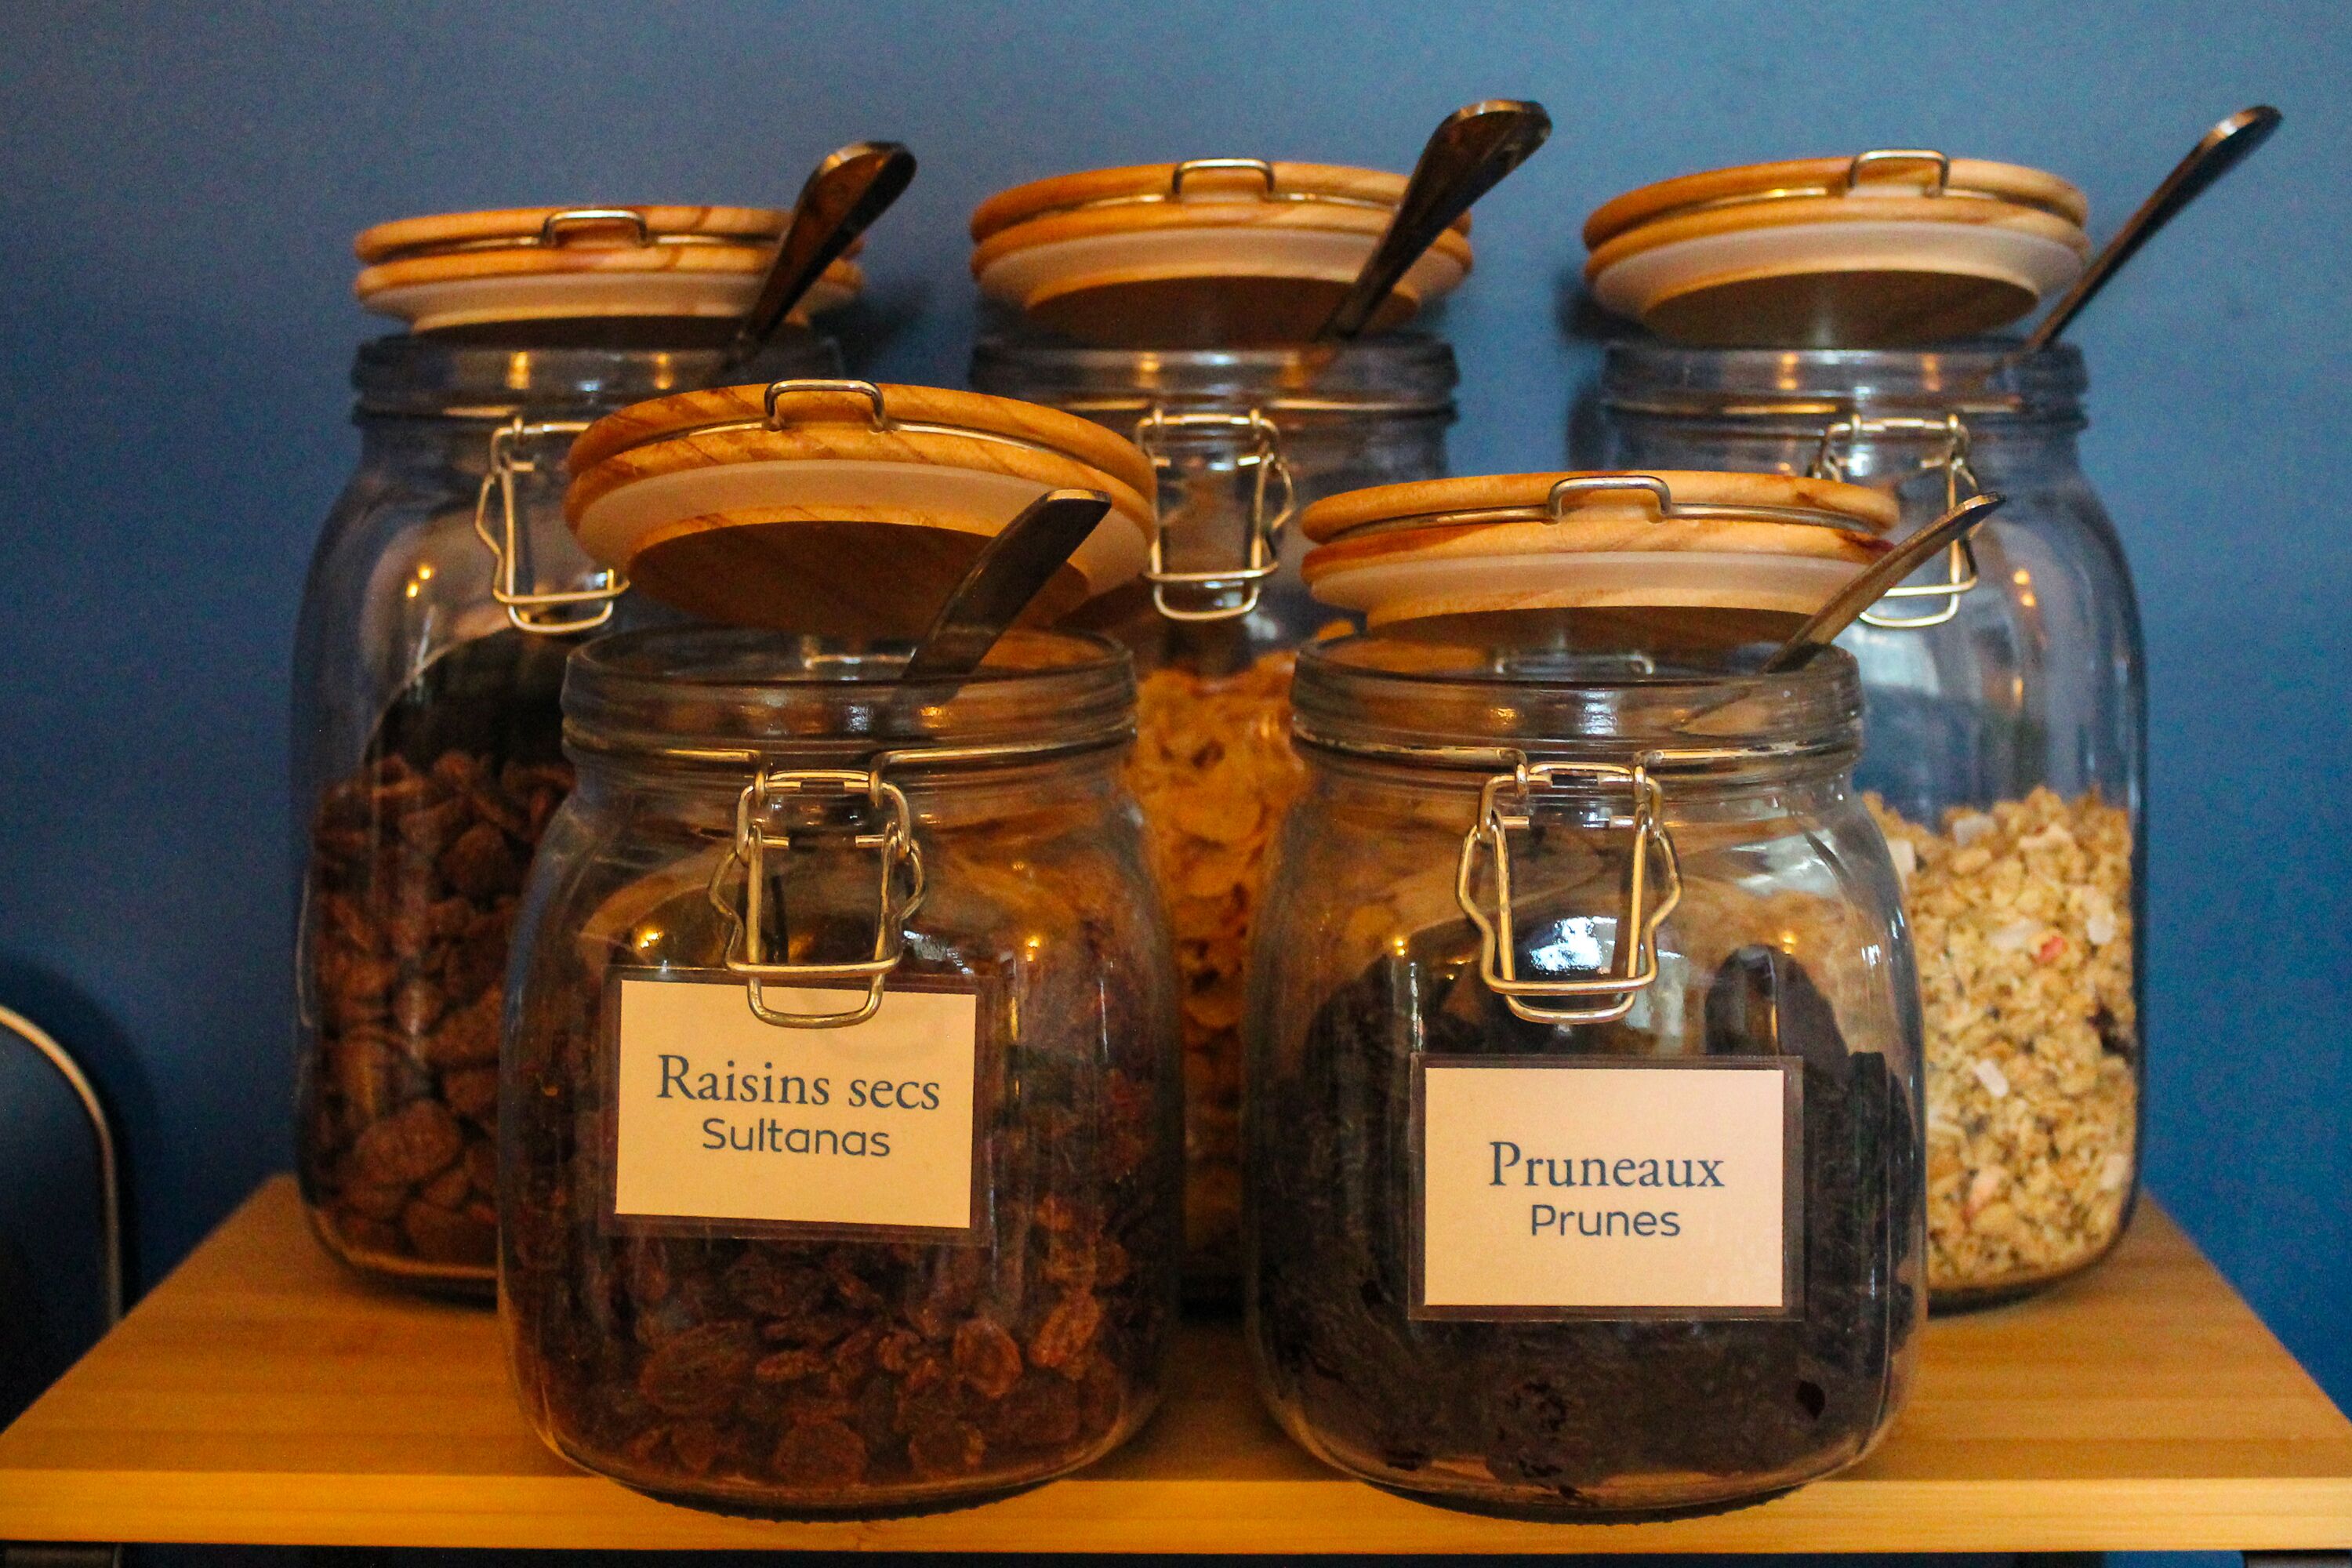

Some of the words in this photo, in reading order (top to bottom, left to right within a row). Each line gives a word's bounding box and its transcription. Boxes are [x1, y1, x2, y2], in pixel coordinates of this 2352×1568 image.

[657, 1054, 829, 1105] Raisins
[849, 1080, 939, 1109] secs
[703, 1118, 890, 1156] Sultanas
[1490, 1142, 1724, 1187] Pruneaux
[1532, 1205, 1679, 1236] Prunes
